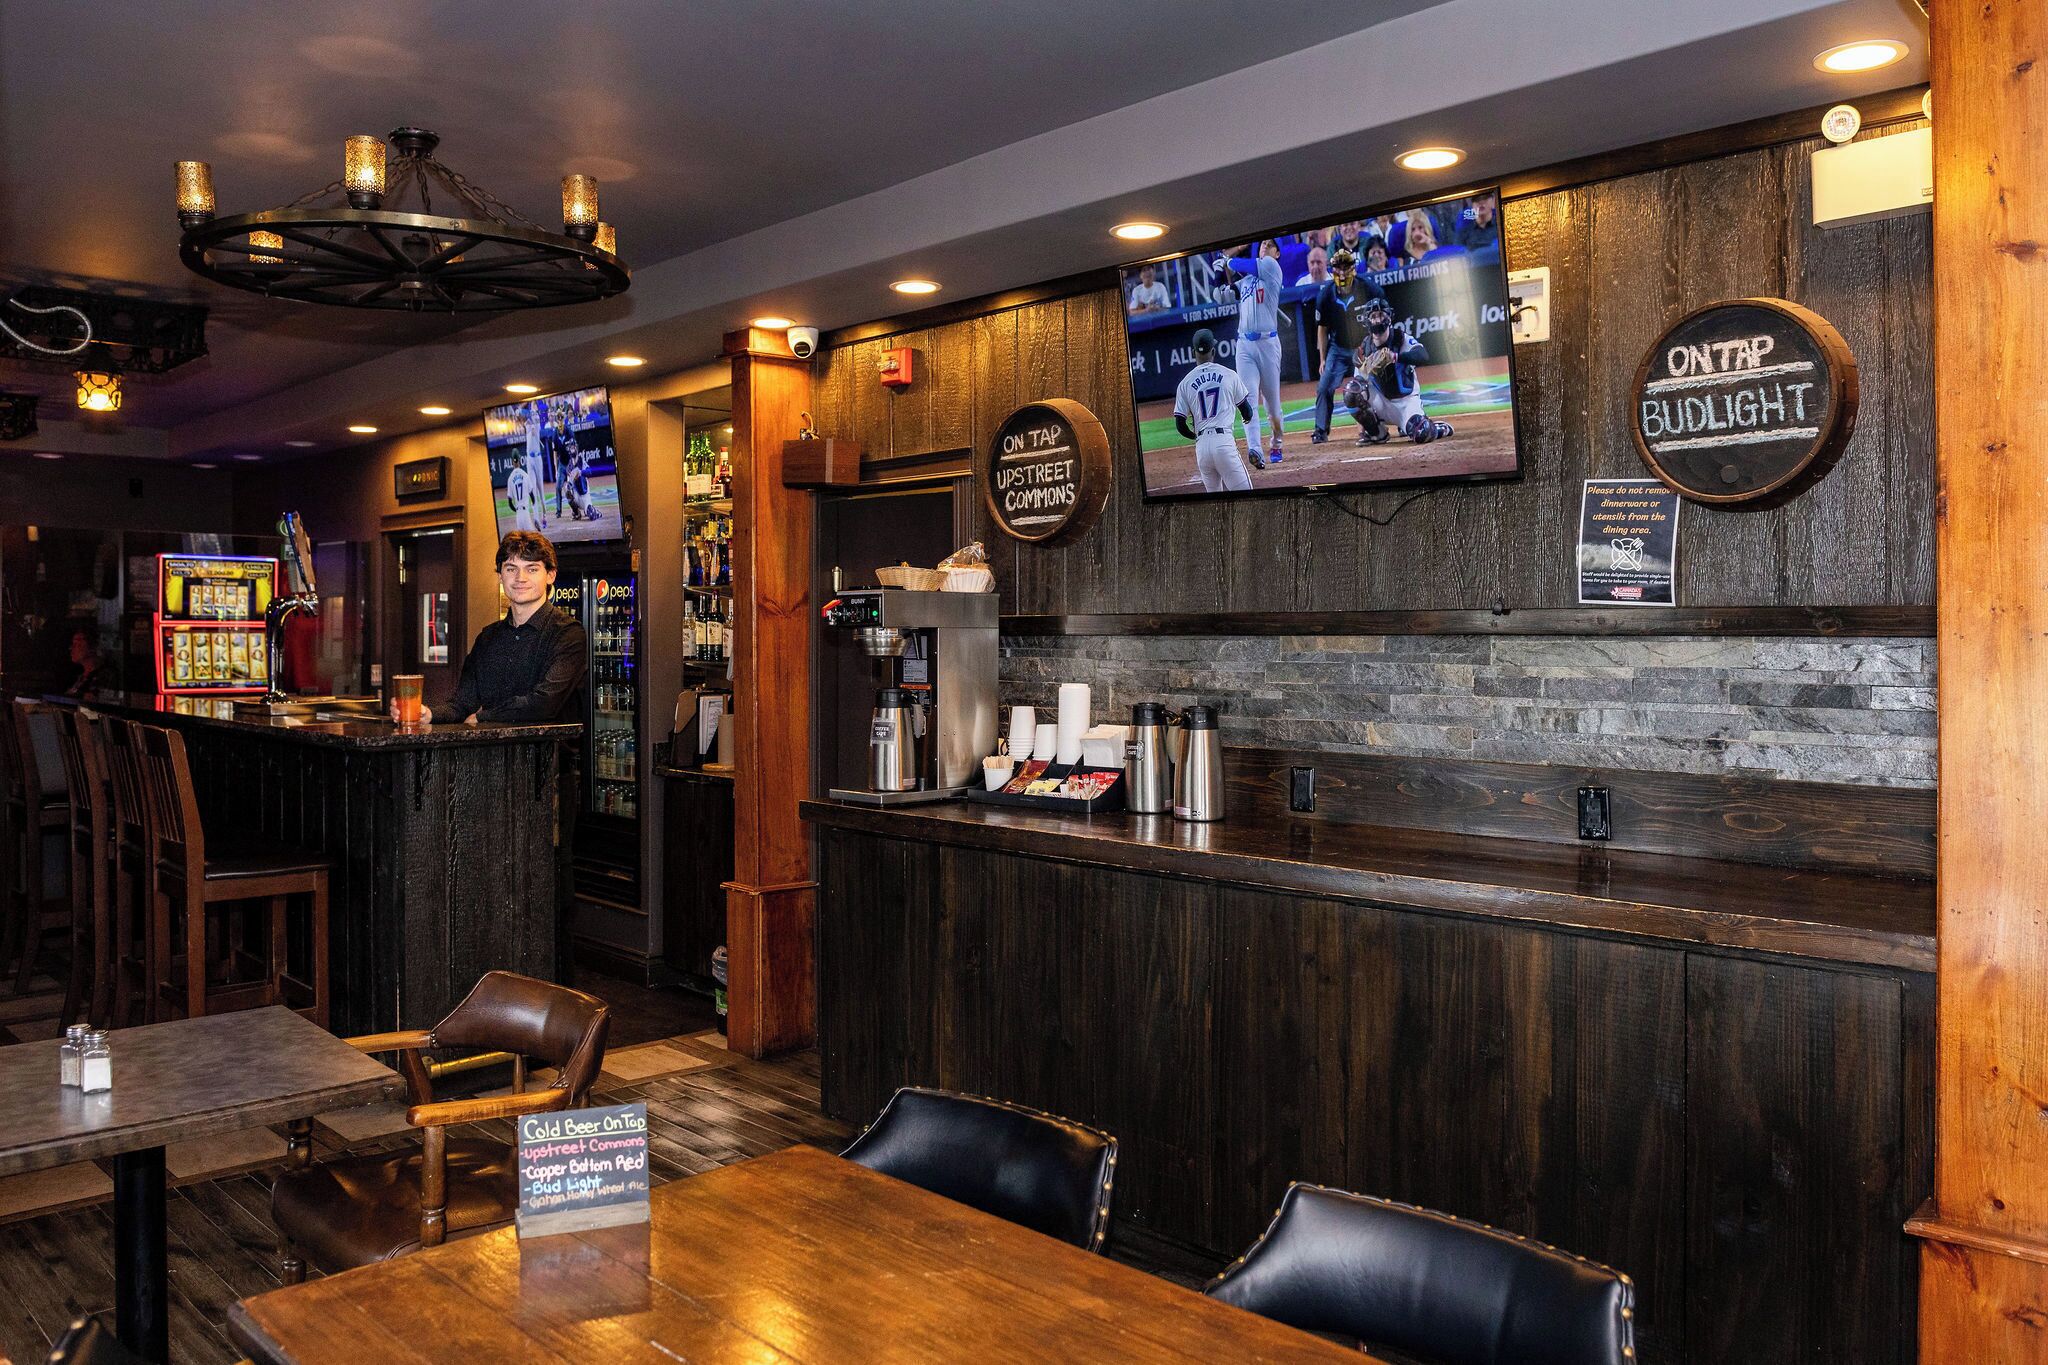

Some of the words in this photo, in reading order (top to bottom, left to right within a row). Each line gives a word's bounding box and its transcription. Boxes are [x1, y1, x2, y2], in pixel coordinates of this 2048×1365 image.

[1374, 269, 1406, 287] FIESTA
[1408, 261, 1450, 281] FRIDAYS
[1189, 311, 1202, 322] FOR
[1218, 304, 1238, 317] PEPSI
[1415, 310, 1460, 339] park
[1170, 346, 1197, 366] ALL
[1198, 386, 1220, 421] 17
[1003, 433, 1024, 454] ON
[1028, 424, 1062, 448] TAP
[996, 459, 1074, 490] UPSTREET
[1005, 482, 1076, 512] COMMONS
[1587, 485, 1614, 495] Please
[1616, 485, 1626, 495] do
[1628, 486, 1643, 495] not
[1601, 499, 1648, 508] dinnerware
[1650, 500, 1661, 508] or
[1592, 512, 1626, 521] utensils
[1627, 512, 1649, 521] from
[1650, 512, 1667, 521] the
[1602, 525, 1628, 536] dining
[610, 585, 634, 600] peps
[523, 1119, 561, 1140] Cold
[565, 1117, 601, 1136] Beer
[589, 1136, 645, 1153] Commons
[569, 1157, 613, 1175] Bottom
[616, 1152, 645, 1172] Red
[567, 1175, 603, 1193] Light
[598, 1182, 625, 1196] Wheat
